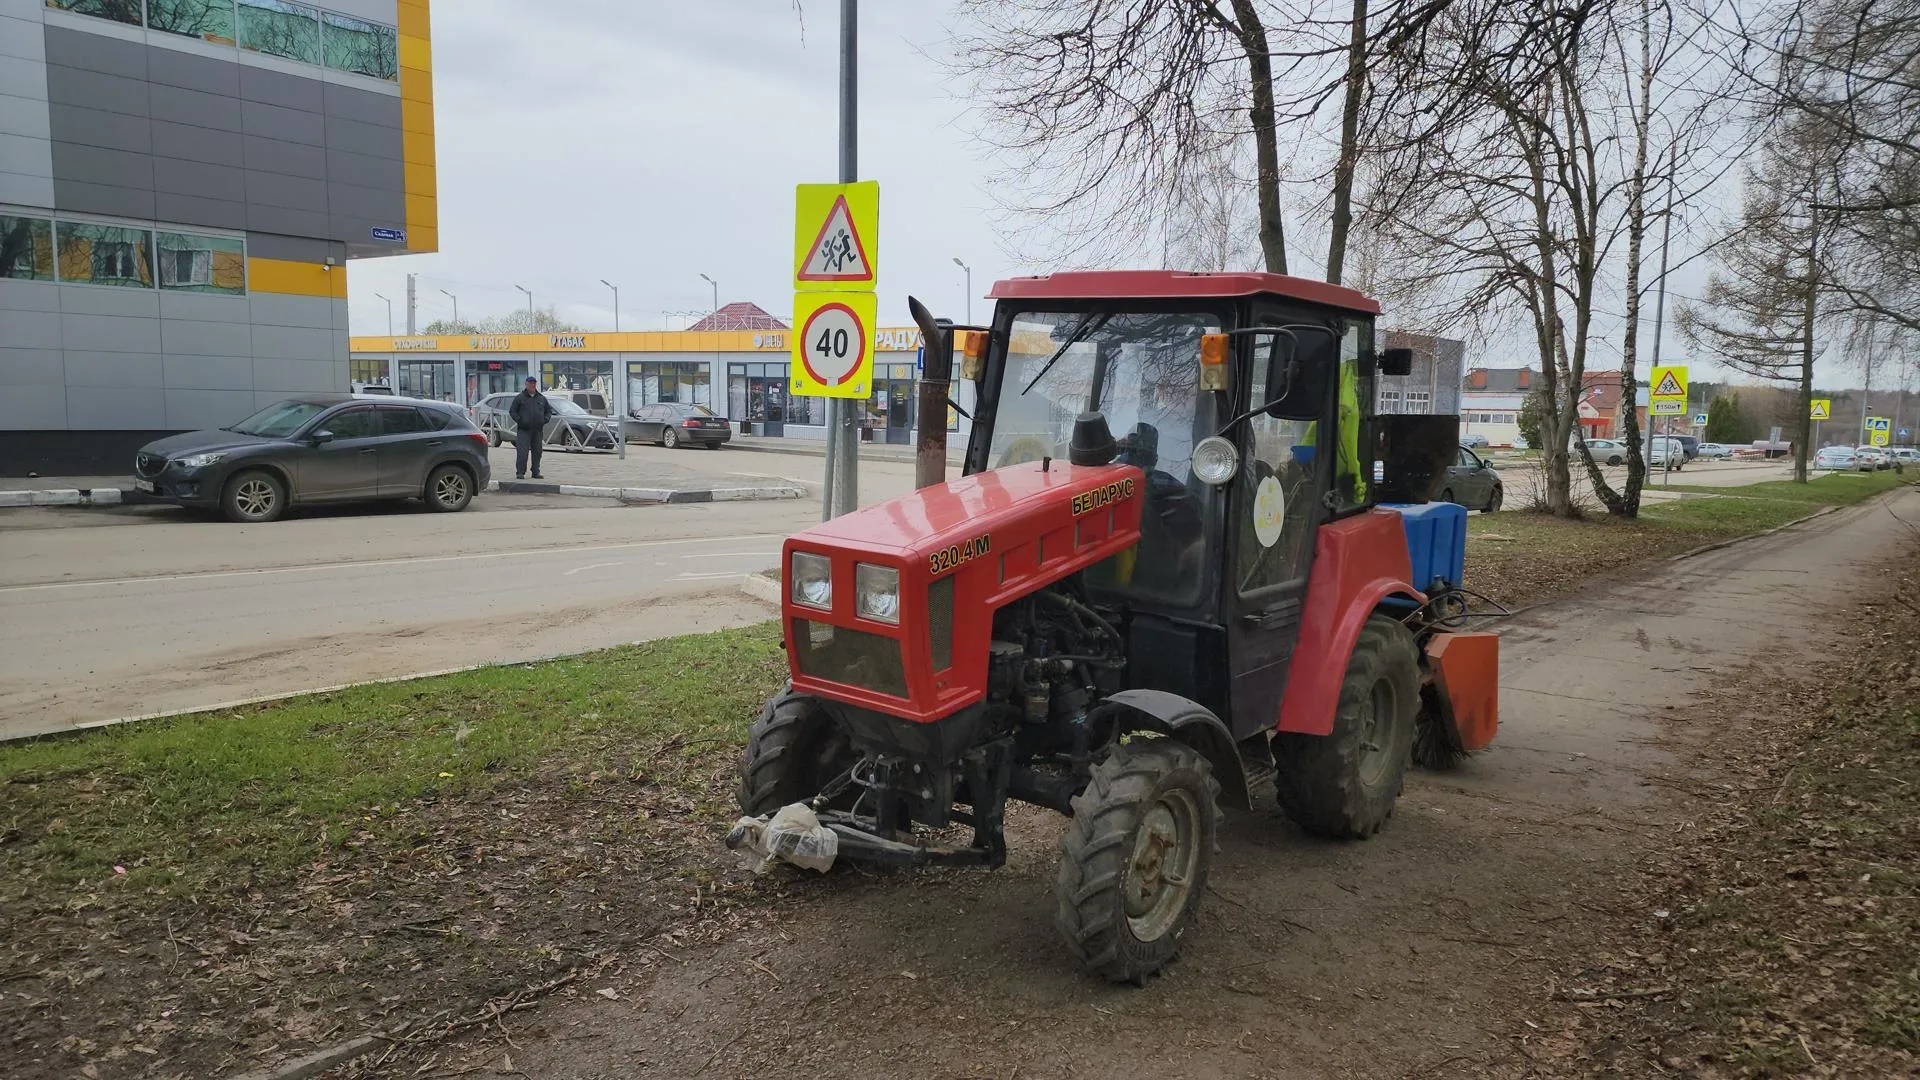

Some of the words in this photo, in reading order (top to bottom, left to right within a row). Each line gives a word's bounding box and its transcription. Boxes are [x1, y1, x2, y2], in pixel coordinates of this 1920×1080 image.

[480, 336, 510, 350] МЯСО
[558, 335, 585, 348] ТАБАК
[816, 328, 848, 358] 40
[875, 331, 919, 351] РАДУ
[1072, 479, 1134, 516] БЕЛАРУС
